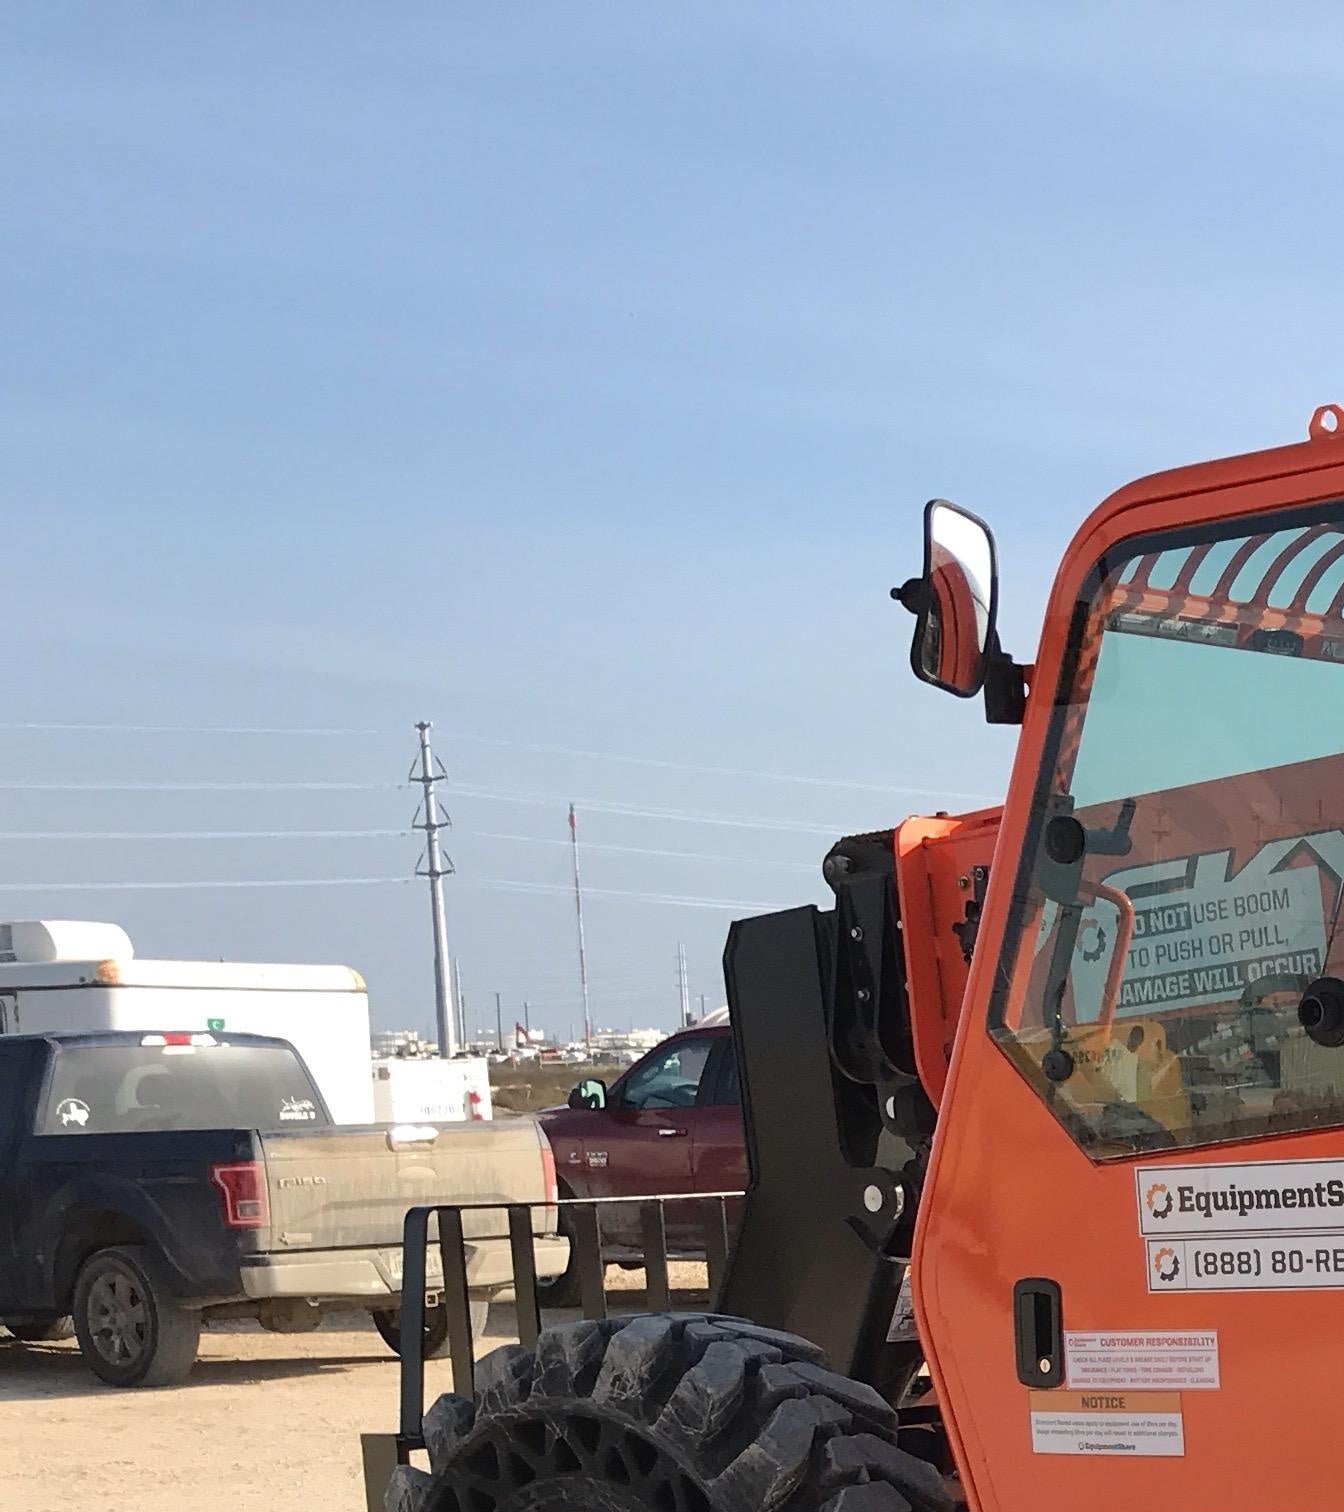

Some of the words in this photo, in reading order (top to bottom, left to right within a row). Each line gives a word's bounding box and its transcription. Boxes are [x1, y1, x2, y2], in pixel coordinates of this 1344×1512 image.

[1150, 907, 1190, 931] NOT
[1192, 900, 1228, 924] USE
[1234, 888, 1290, 917] BOOM
[1129, 949, 1151, 970] TO
[1155, 942, 1202, 966] PUSH
[1208, 932, 1234, 955] OR
[1239, 924, 1290, 951] PULL,
[1114, 974, 1191, 1005] AMAGE
[1192, 965, 1245, 992] WILL
[1247, 952, 1319, 980] OCCUR
[1194, 1249, 1262, 1278] (888)
[1100, 1337, 1145, 1347] CUSTOMER
[1081, 1396, 1126, 1409] NOTICE
